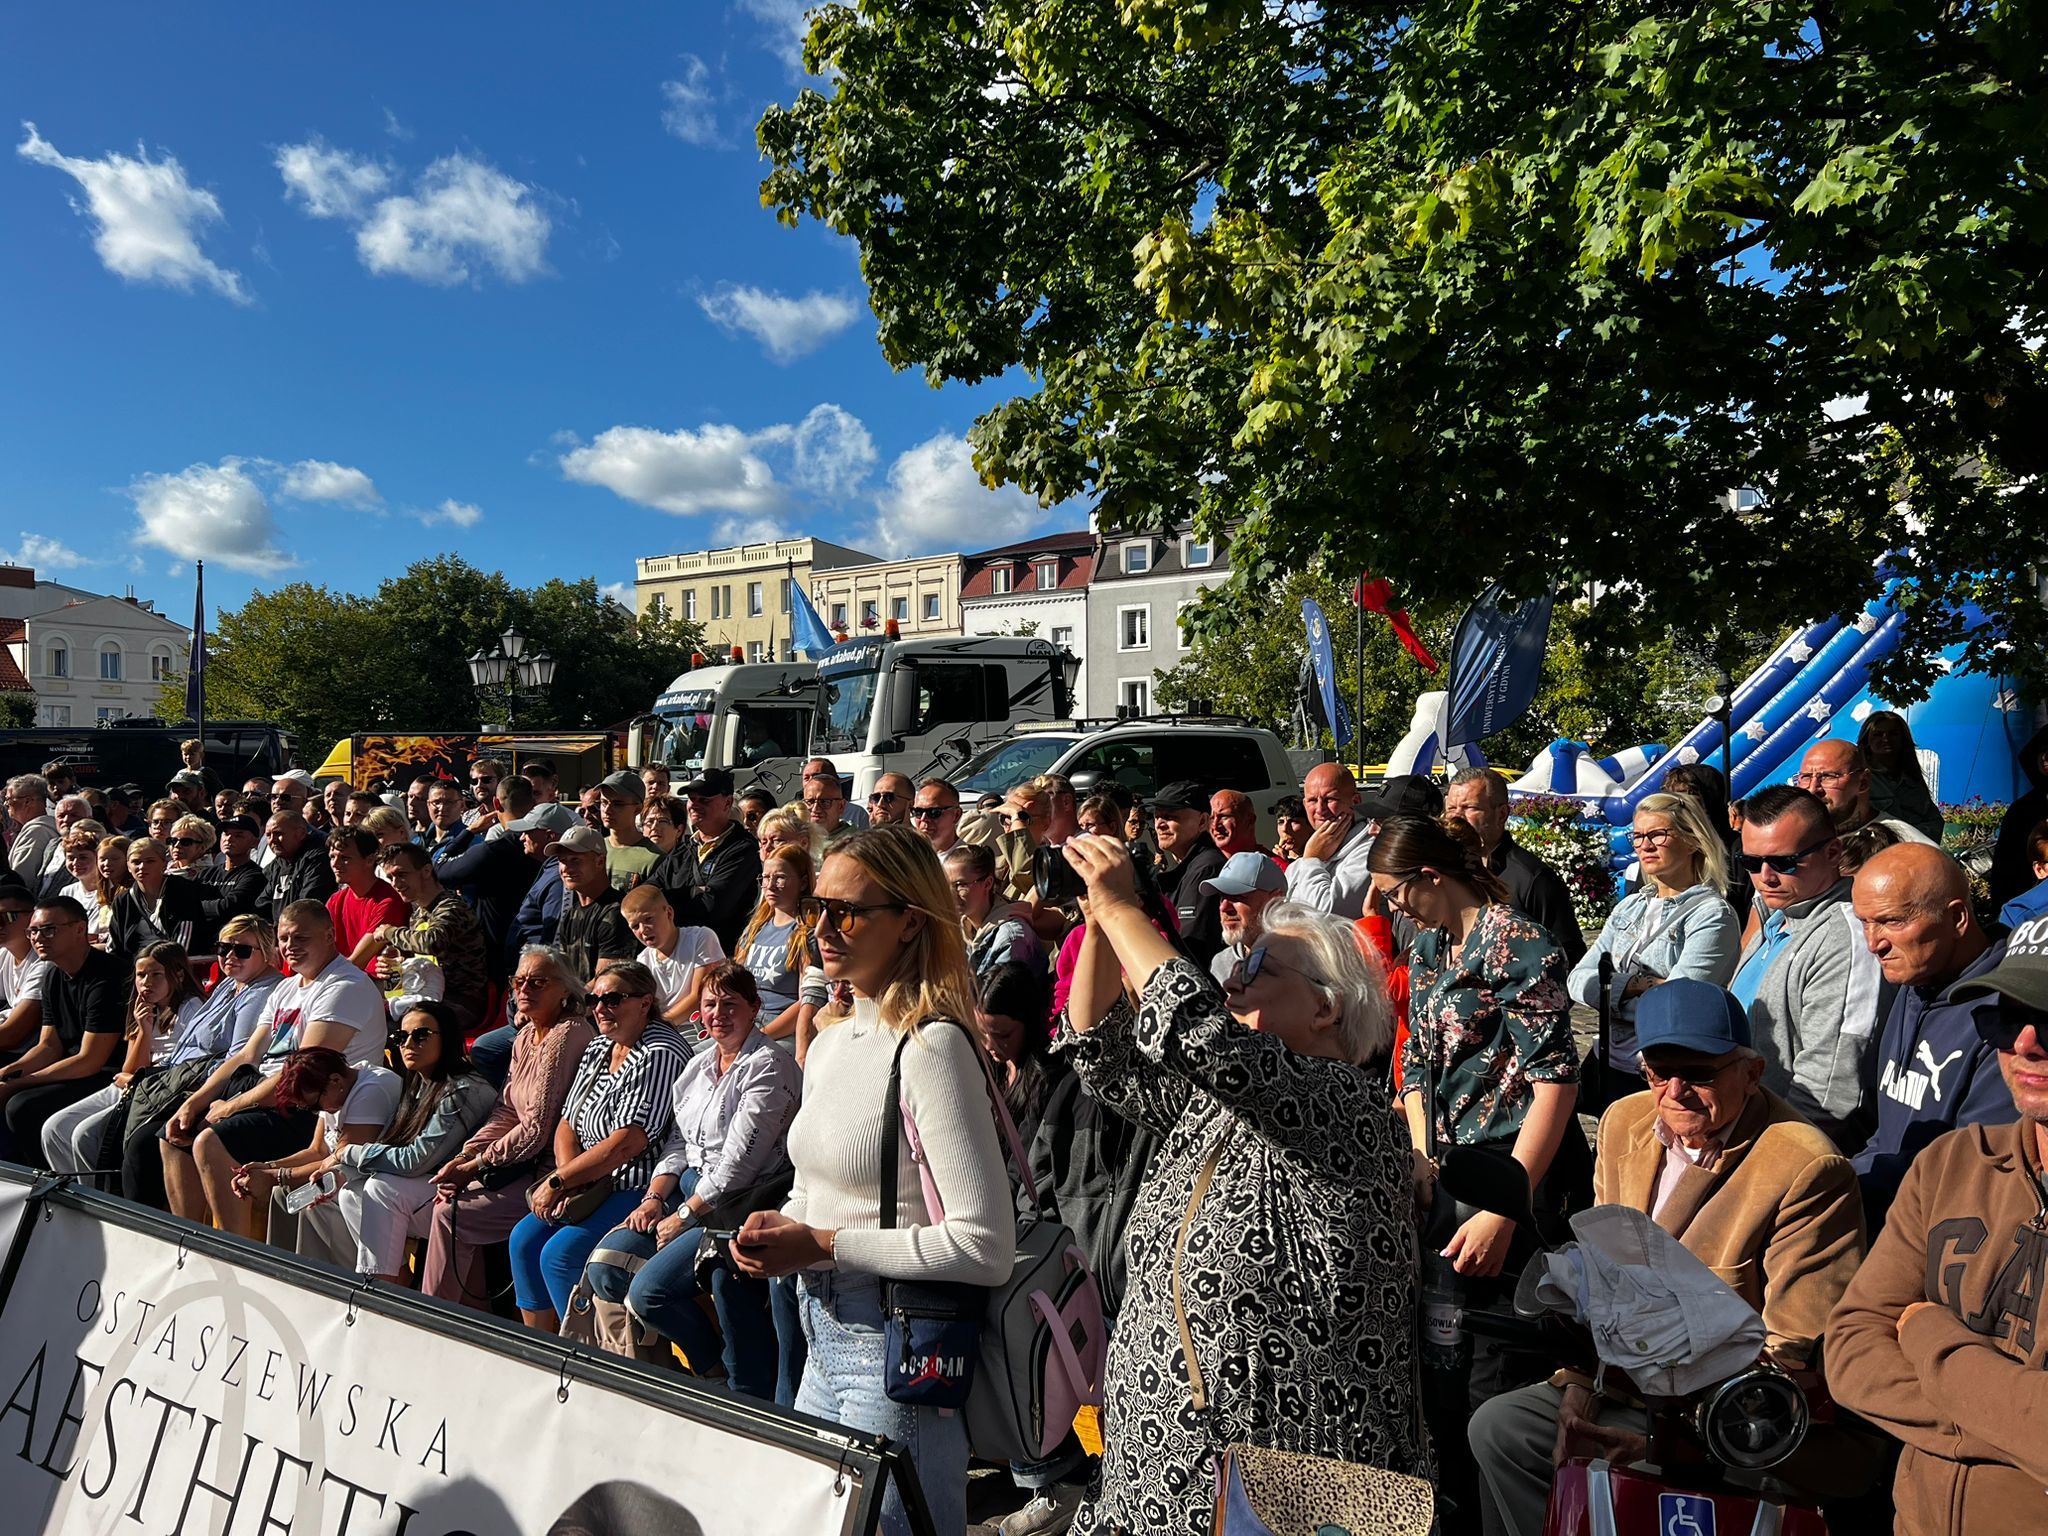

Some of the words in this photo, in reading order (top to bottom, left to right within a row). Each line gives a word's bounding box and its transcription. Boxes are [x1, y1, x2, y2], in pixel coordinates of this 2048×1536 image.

[1500, 664, 1511, 694] GDYNI
[745, 1127, 760, 1156] more
[1925, 1217, 2048, 1372] GA
[75, 1279, 449, 1476] OSTASZEWSKA
